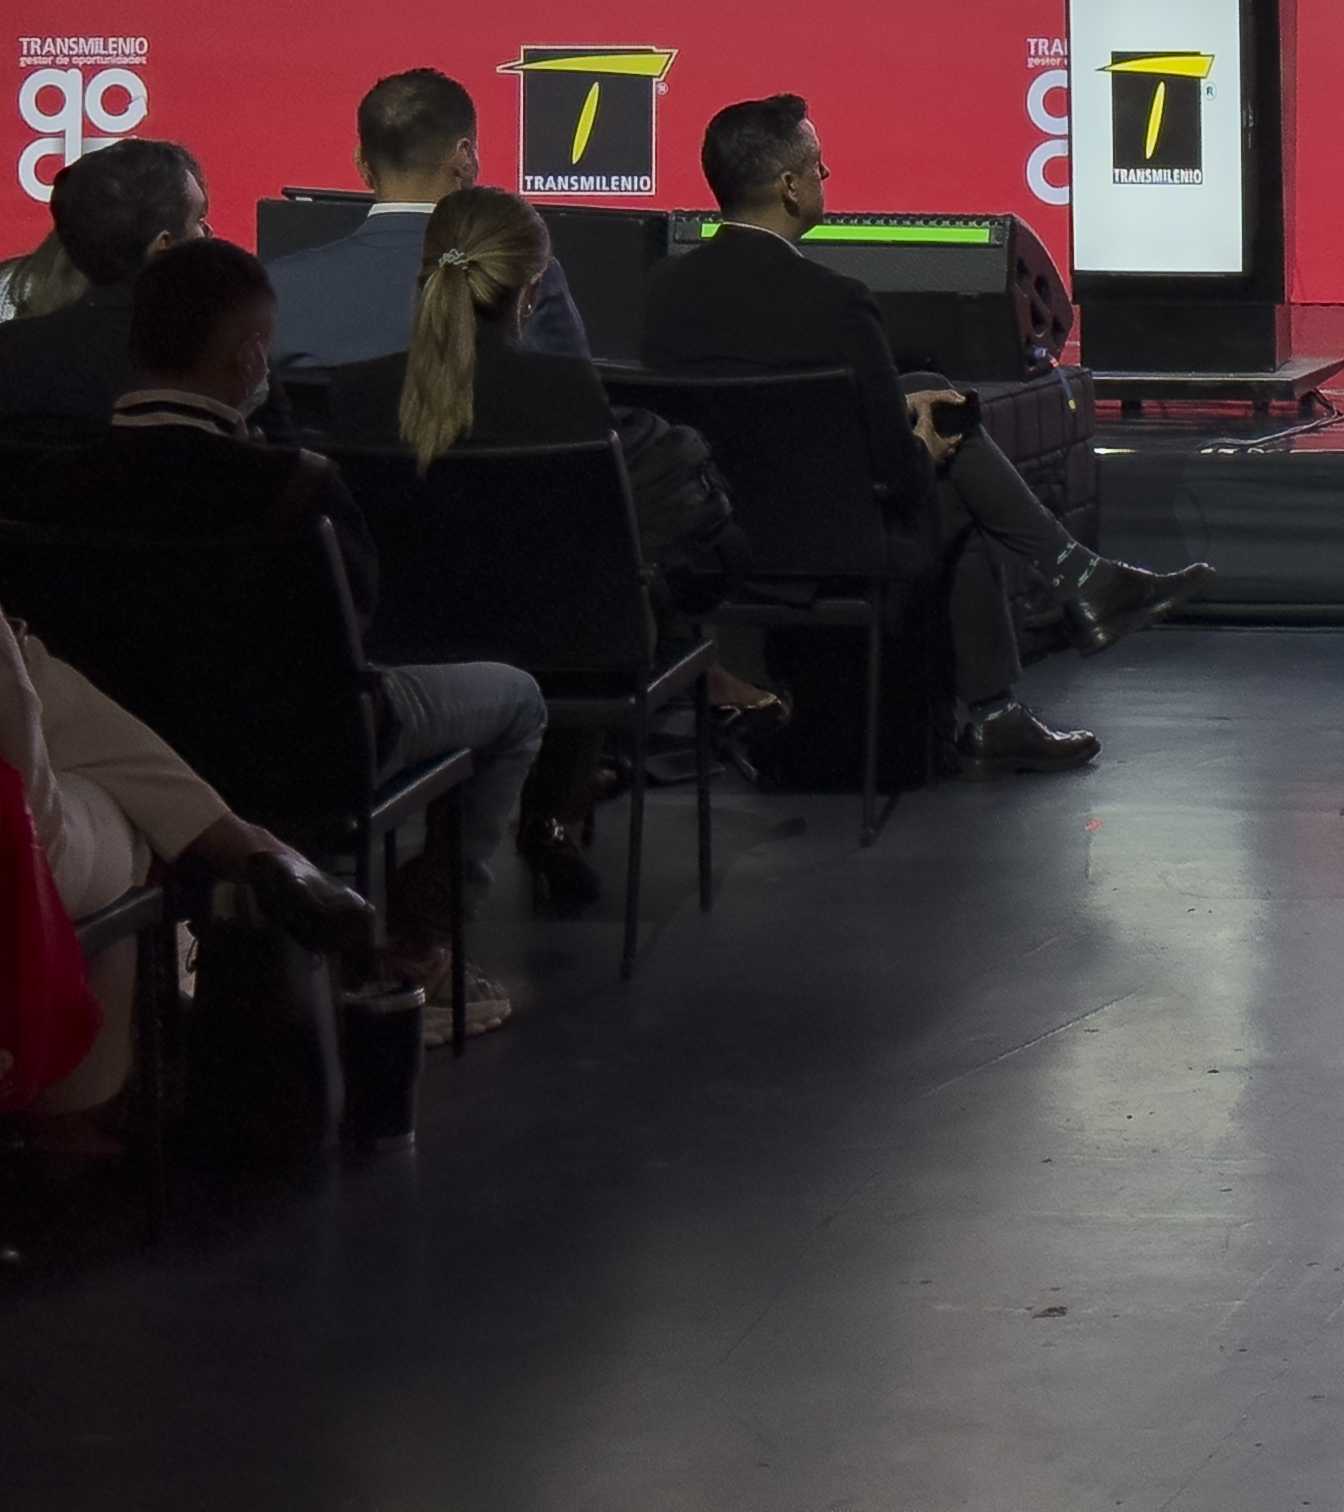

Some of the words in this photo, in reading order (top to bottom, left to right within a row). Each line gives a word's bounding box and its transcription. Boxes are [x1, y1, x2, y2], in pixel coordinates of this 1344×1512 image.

[18, 37, 149, 55] TRANSMILENIO
[19, 55, 54, 68] gestor
[56, 55, 69, 65] de
[18, 68, 148, 202] go
[524, 175, 651, 190] TRANSMILENIO
[1113, 168, 1202, 183] TRANSMILENIO
